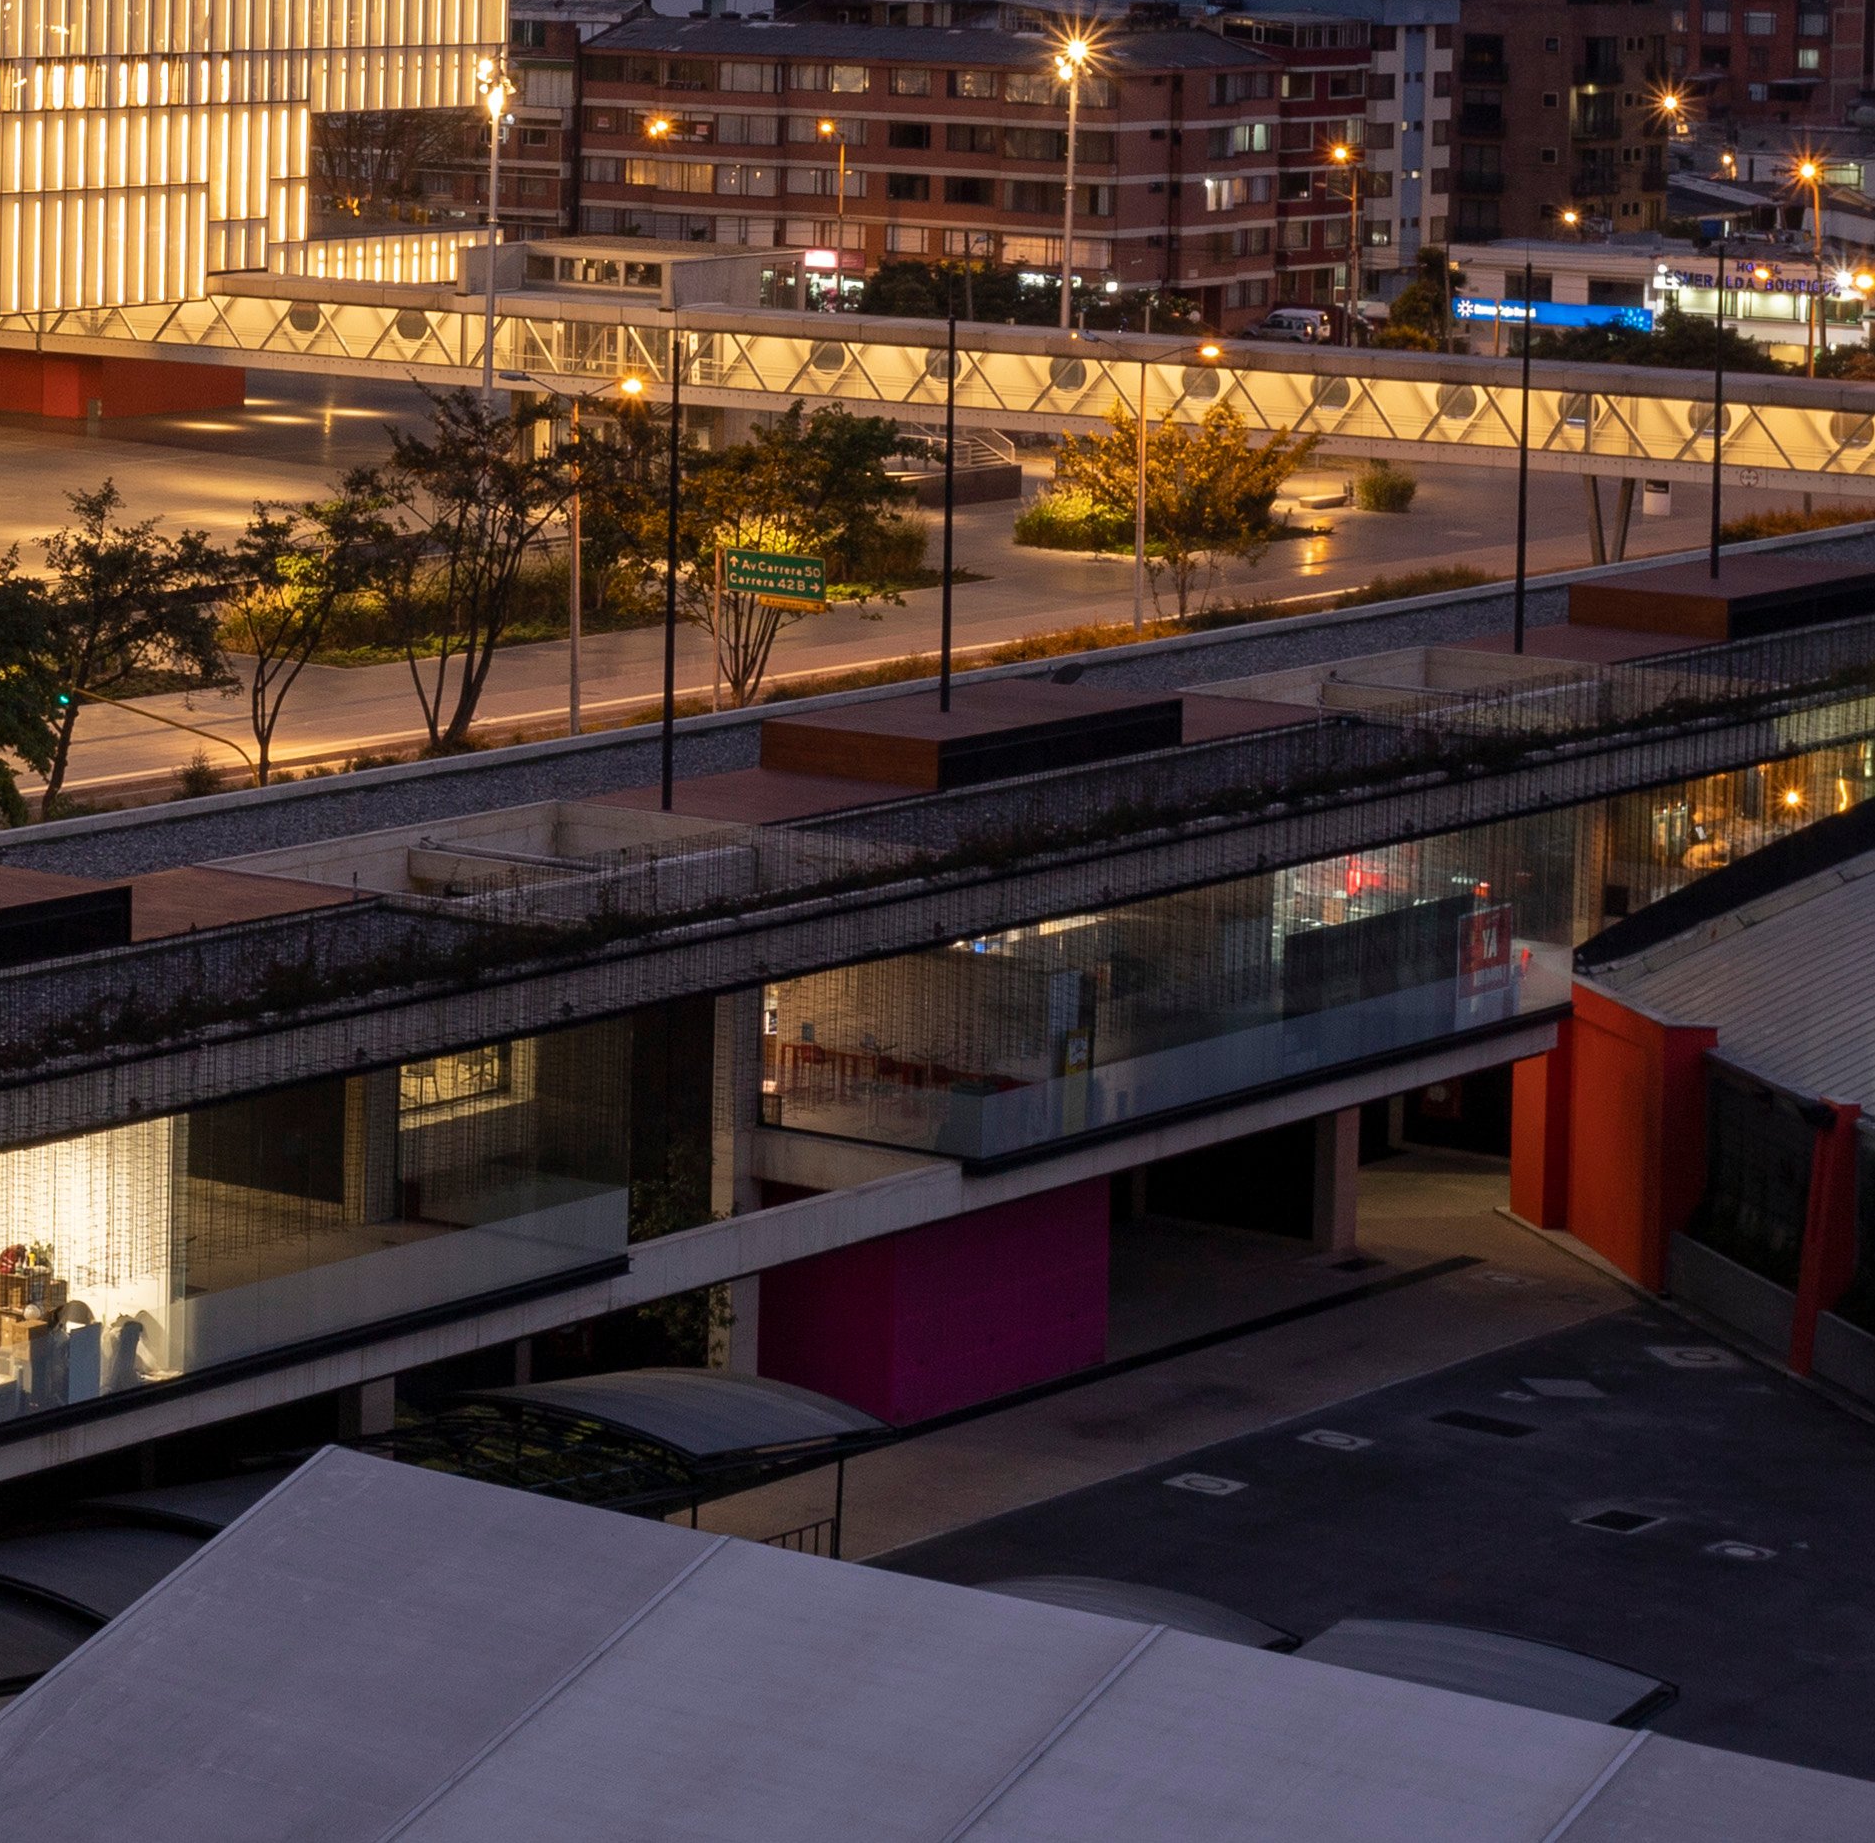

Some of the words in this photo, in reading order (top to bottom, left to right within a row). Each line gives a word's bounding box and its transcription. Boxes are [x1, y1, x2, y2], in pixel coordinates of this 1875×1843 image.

[741, 559, 756, 571] Av
[758, 560, 802, 577] Carrera
[804, 566, 821, 579] 50
[729, 572, 775, 588] Carrera
